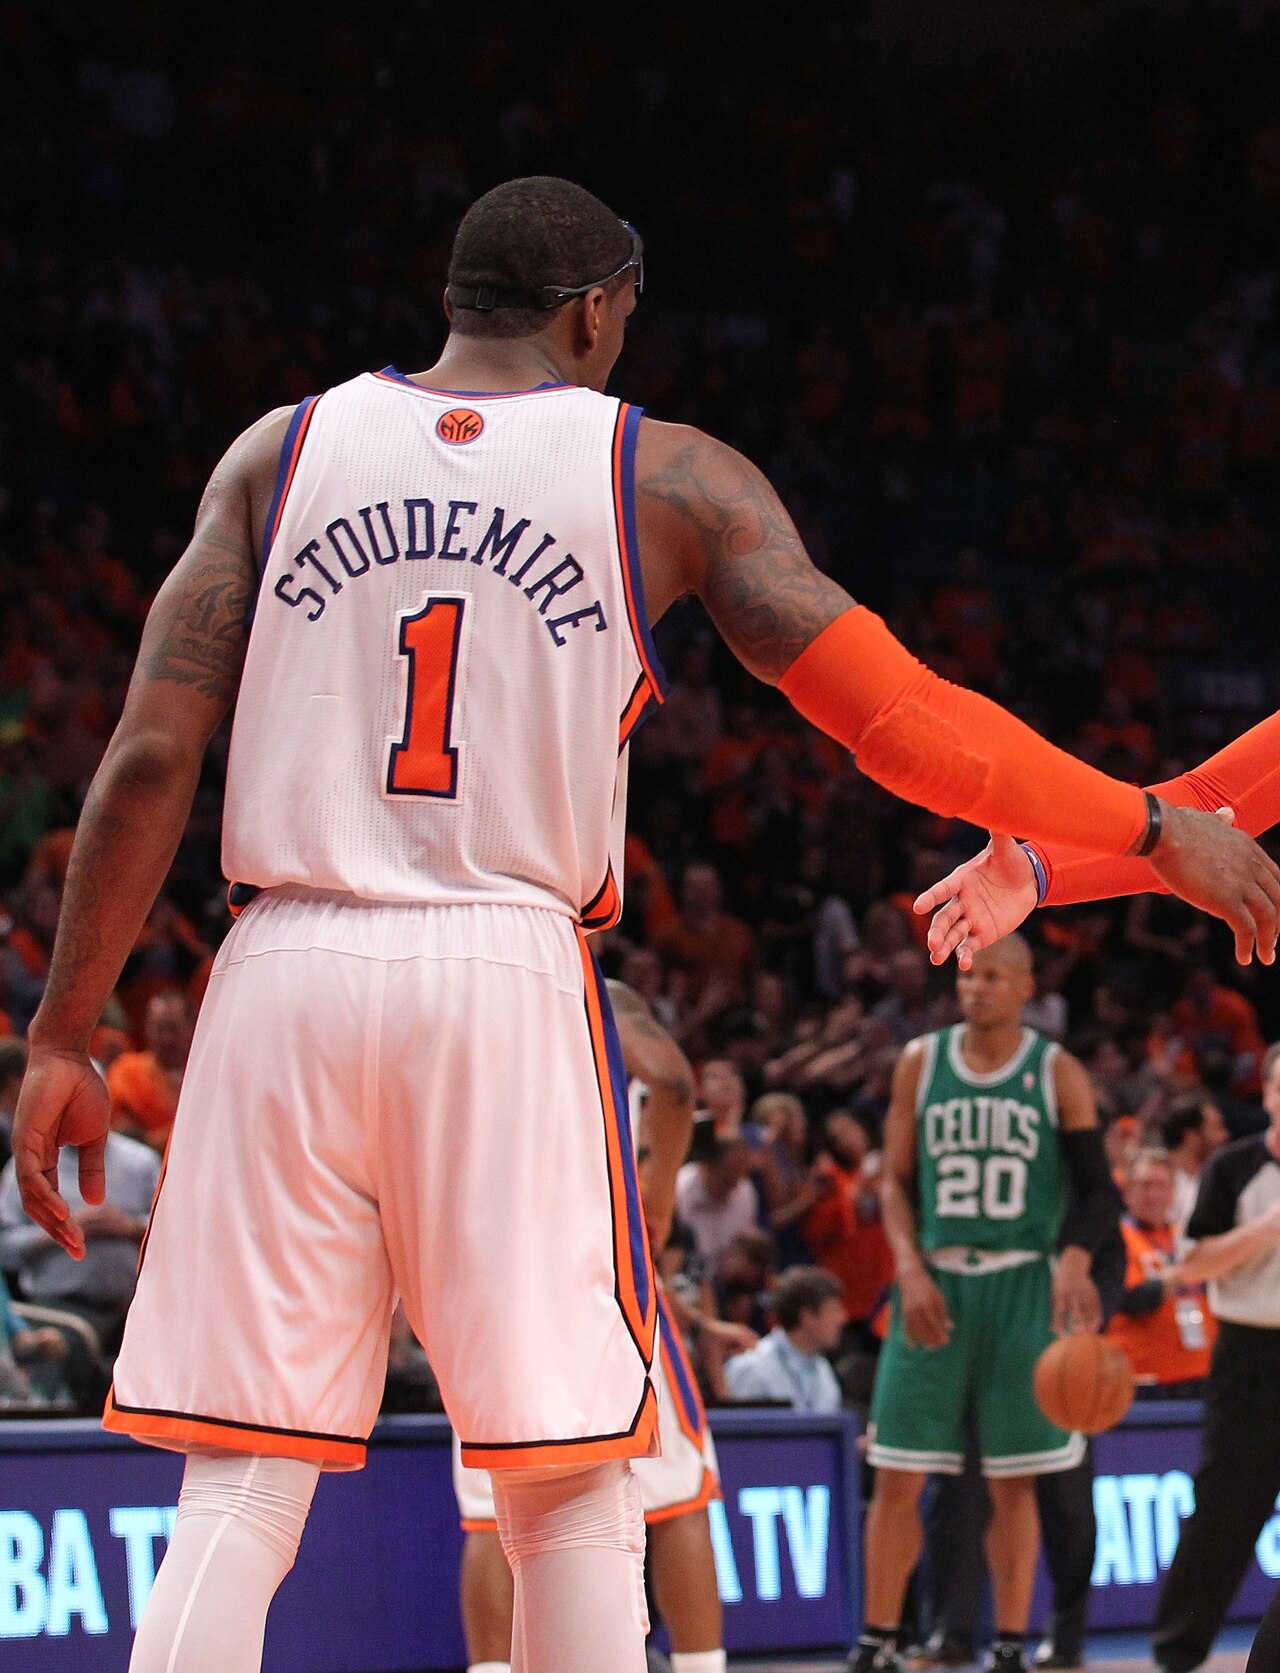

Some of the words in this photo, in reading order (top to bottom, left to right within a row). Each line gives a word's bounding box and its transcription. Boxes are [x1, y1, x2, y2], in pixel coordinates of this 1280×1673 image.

[274, 497, 608, 649] STOUDEMIRE
[385, 596, 468, 799] 1
[925, 1096, 1041, 1161] CELTICS
[936, 1153, 1028, 1221] 20
[108, 1506, 180, 1632] T
[738, 1484, 831, 1601] TV
